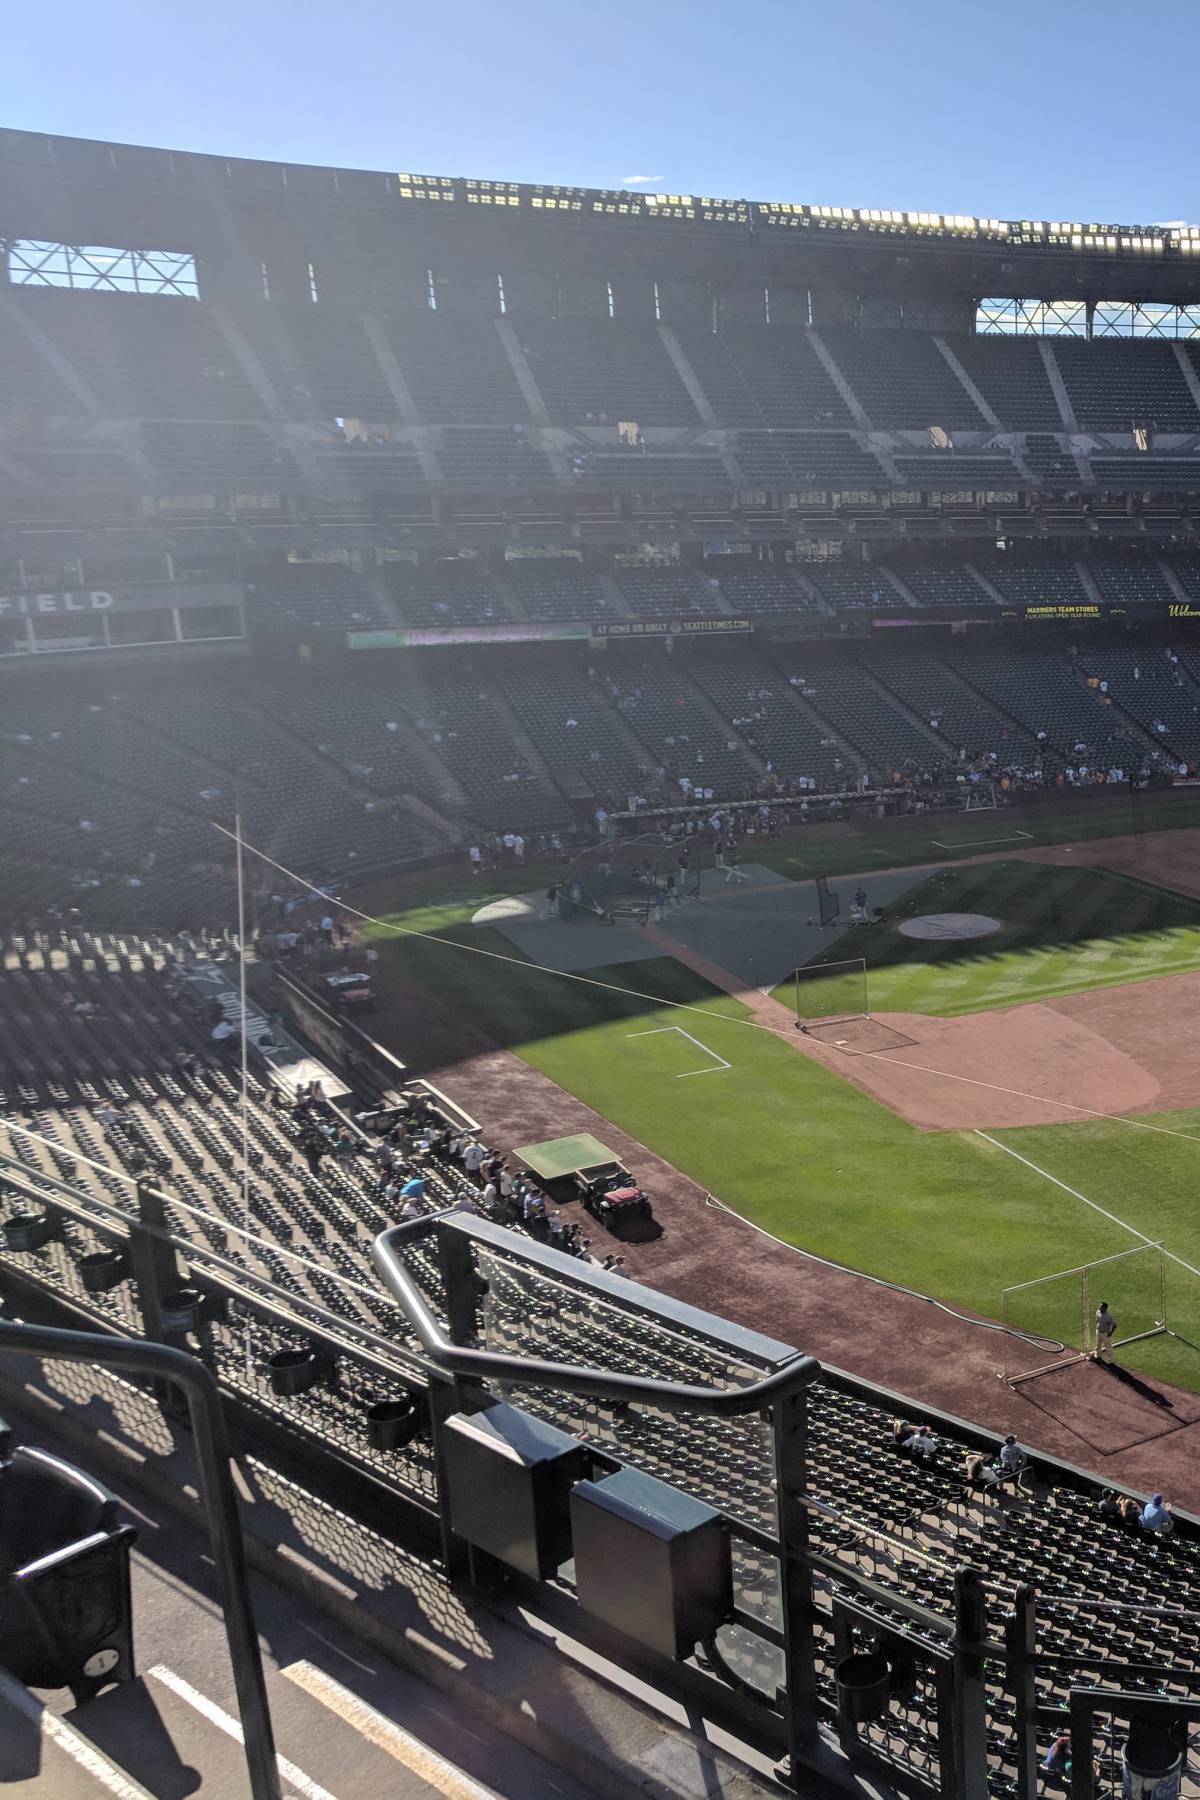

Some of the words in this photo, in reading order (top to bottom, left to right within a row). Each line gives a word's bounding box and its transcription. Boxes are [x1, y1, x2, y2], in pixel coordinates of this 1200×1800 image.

[0, 591, 114, 614] FIELD
[1027, 606, 1057, 614] MARINERS
[645, 623, 667, 633] AWAY
[683, 620, 749, 632] SEATTLETIMES.COM
